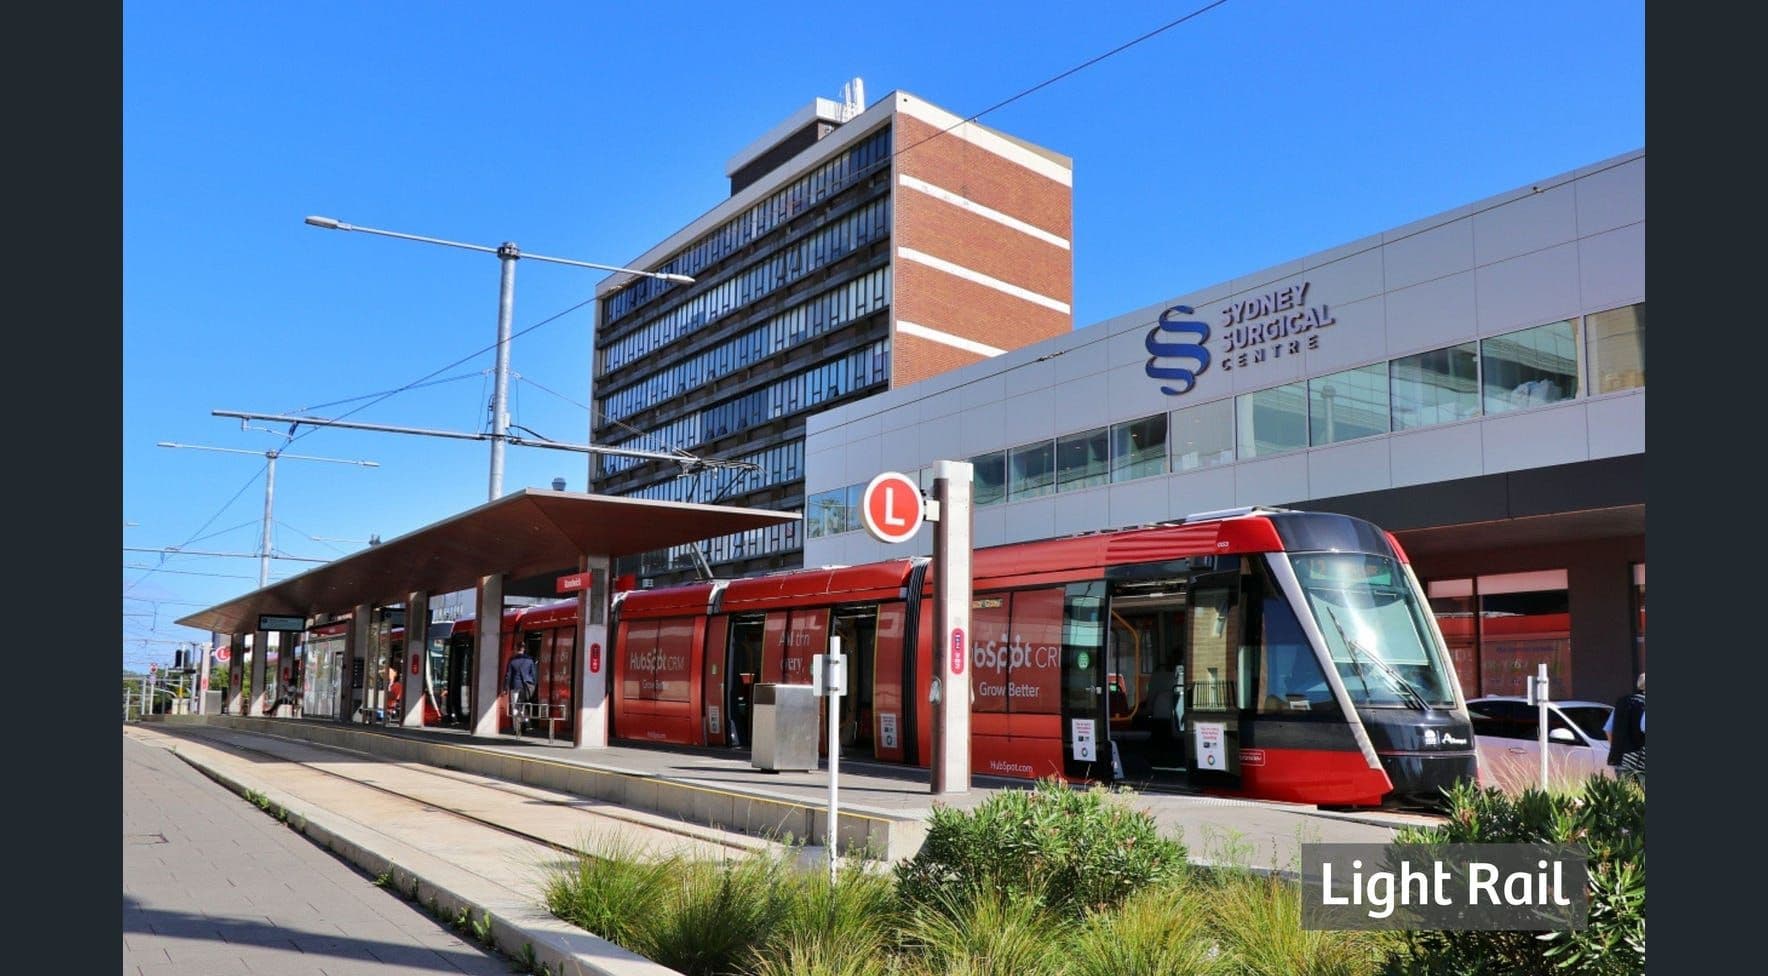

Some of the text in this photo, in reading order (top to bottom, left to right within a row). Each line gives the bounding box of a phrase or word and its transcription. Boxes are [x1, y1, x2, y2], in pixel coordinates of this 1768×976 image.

[1222, 281, 1311, 328] SYDNEY
[1223, 304, 1336, 354] SURGICAL
[1221, 334, 1319, 371] CENTRE
[884, 487, 905, 527] L
[630, 647, 666, 674] HubSpot
[971, 633, 1032, 675] bSpot
[1035, 646, 1061, 669] CR
[980, 681, 1040, 698] Grow Better
[990, 760, 1034, 773] HubSpot.com
